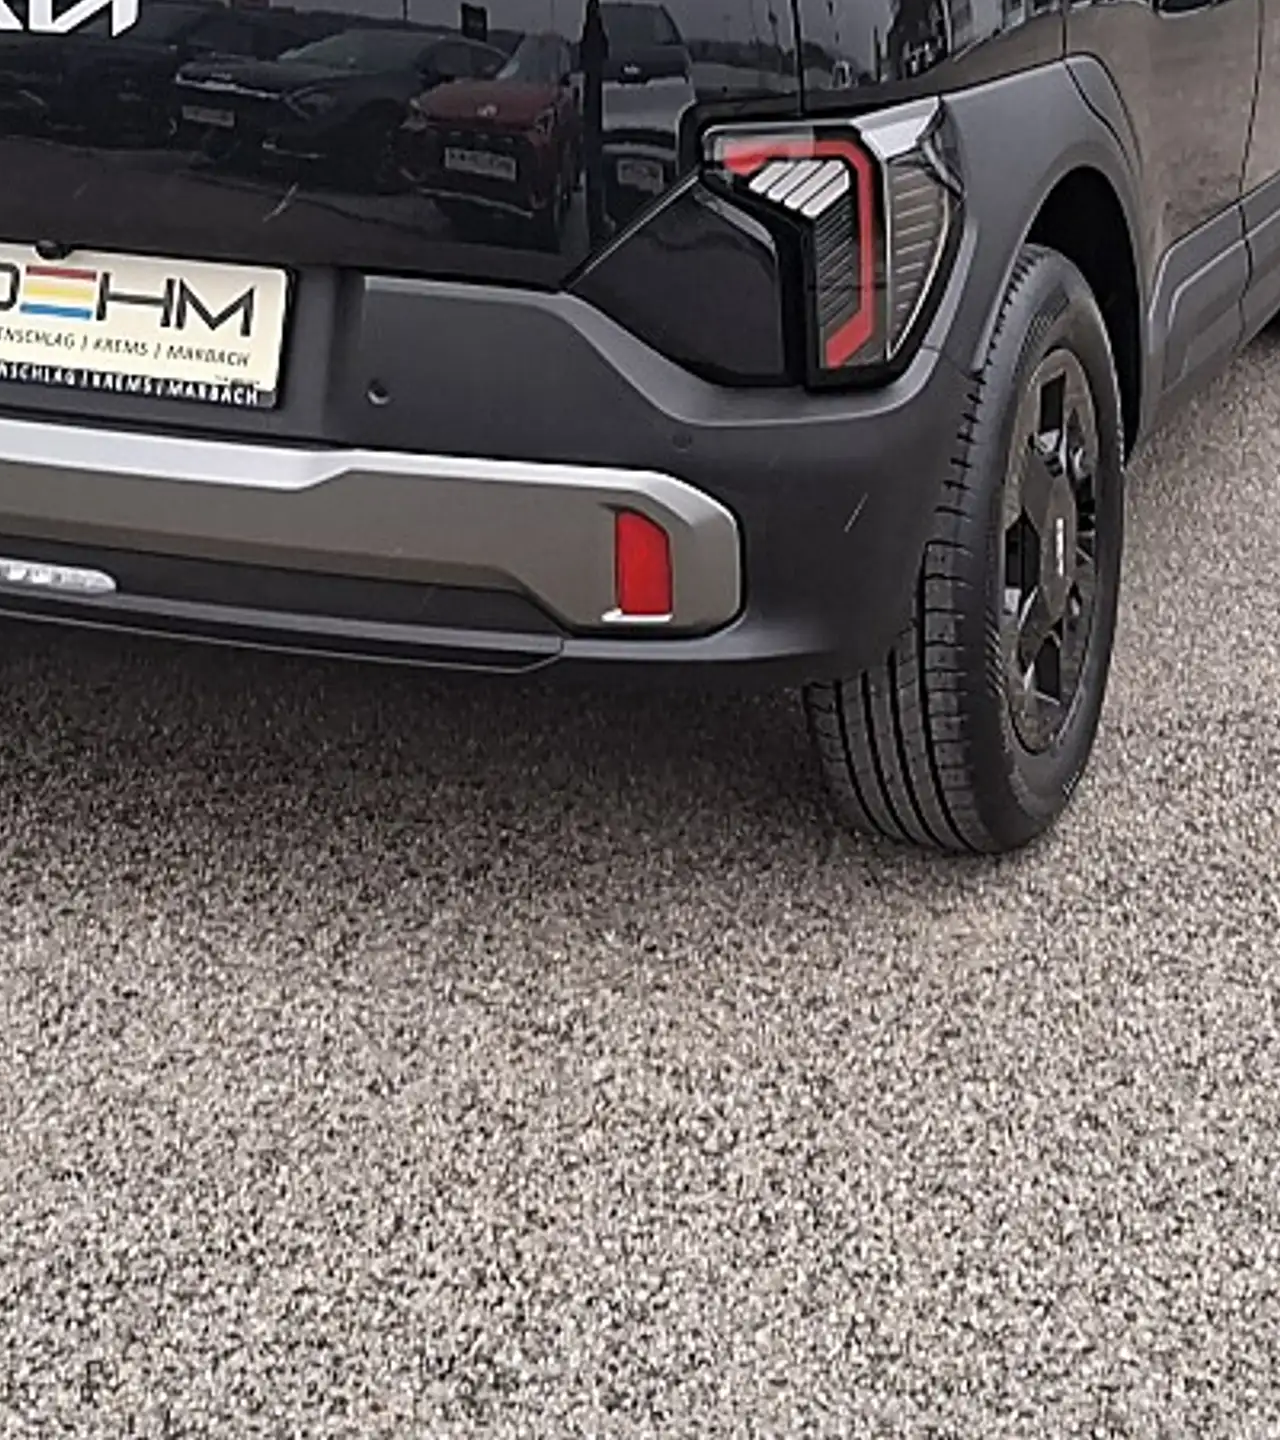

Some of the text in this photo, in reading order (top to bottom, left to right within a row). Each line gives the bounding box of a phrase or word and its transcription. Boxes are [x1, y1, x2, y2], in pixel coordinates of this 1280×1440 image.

[93, 338, 149, 358] KREMS
[166, 345, 251, 368] MARBACH
[92, 373, 152, 395] KREMS
[168, 380, 259, 406] MARBACH
